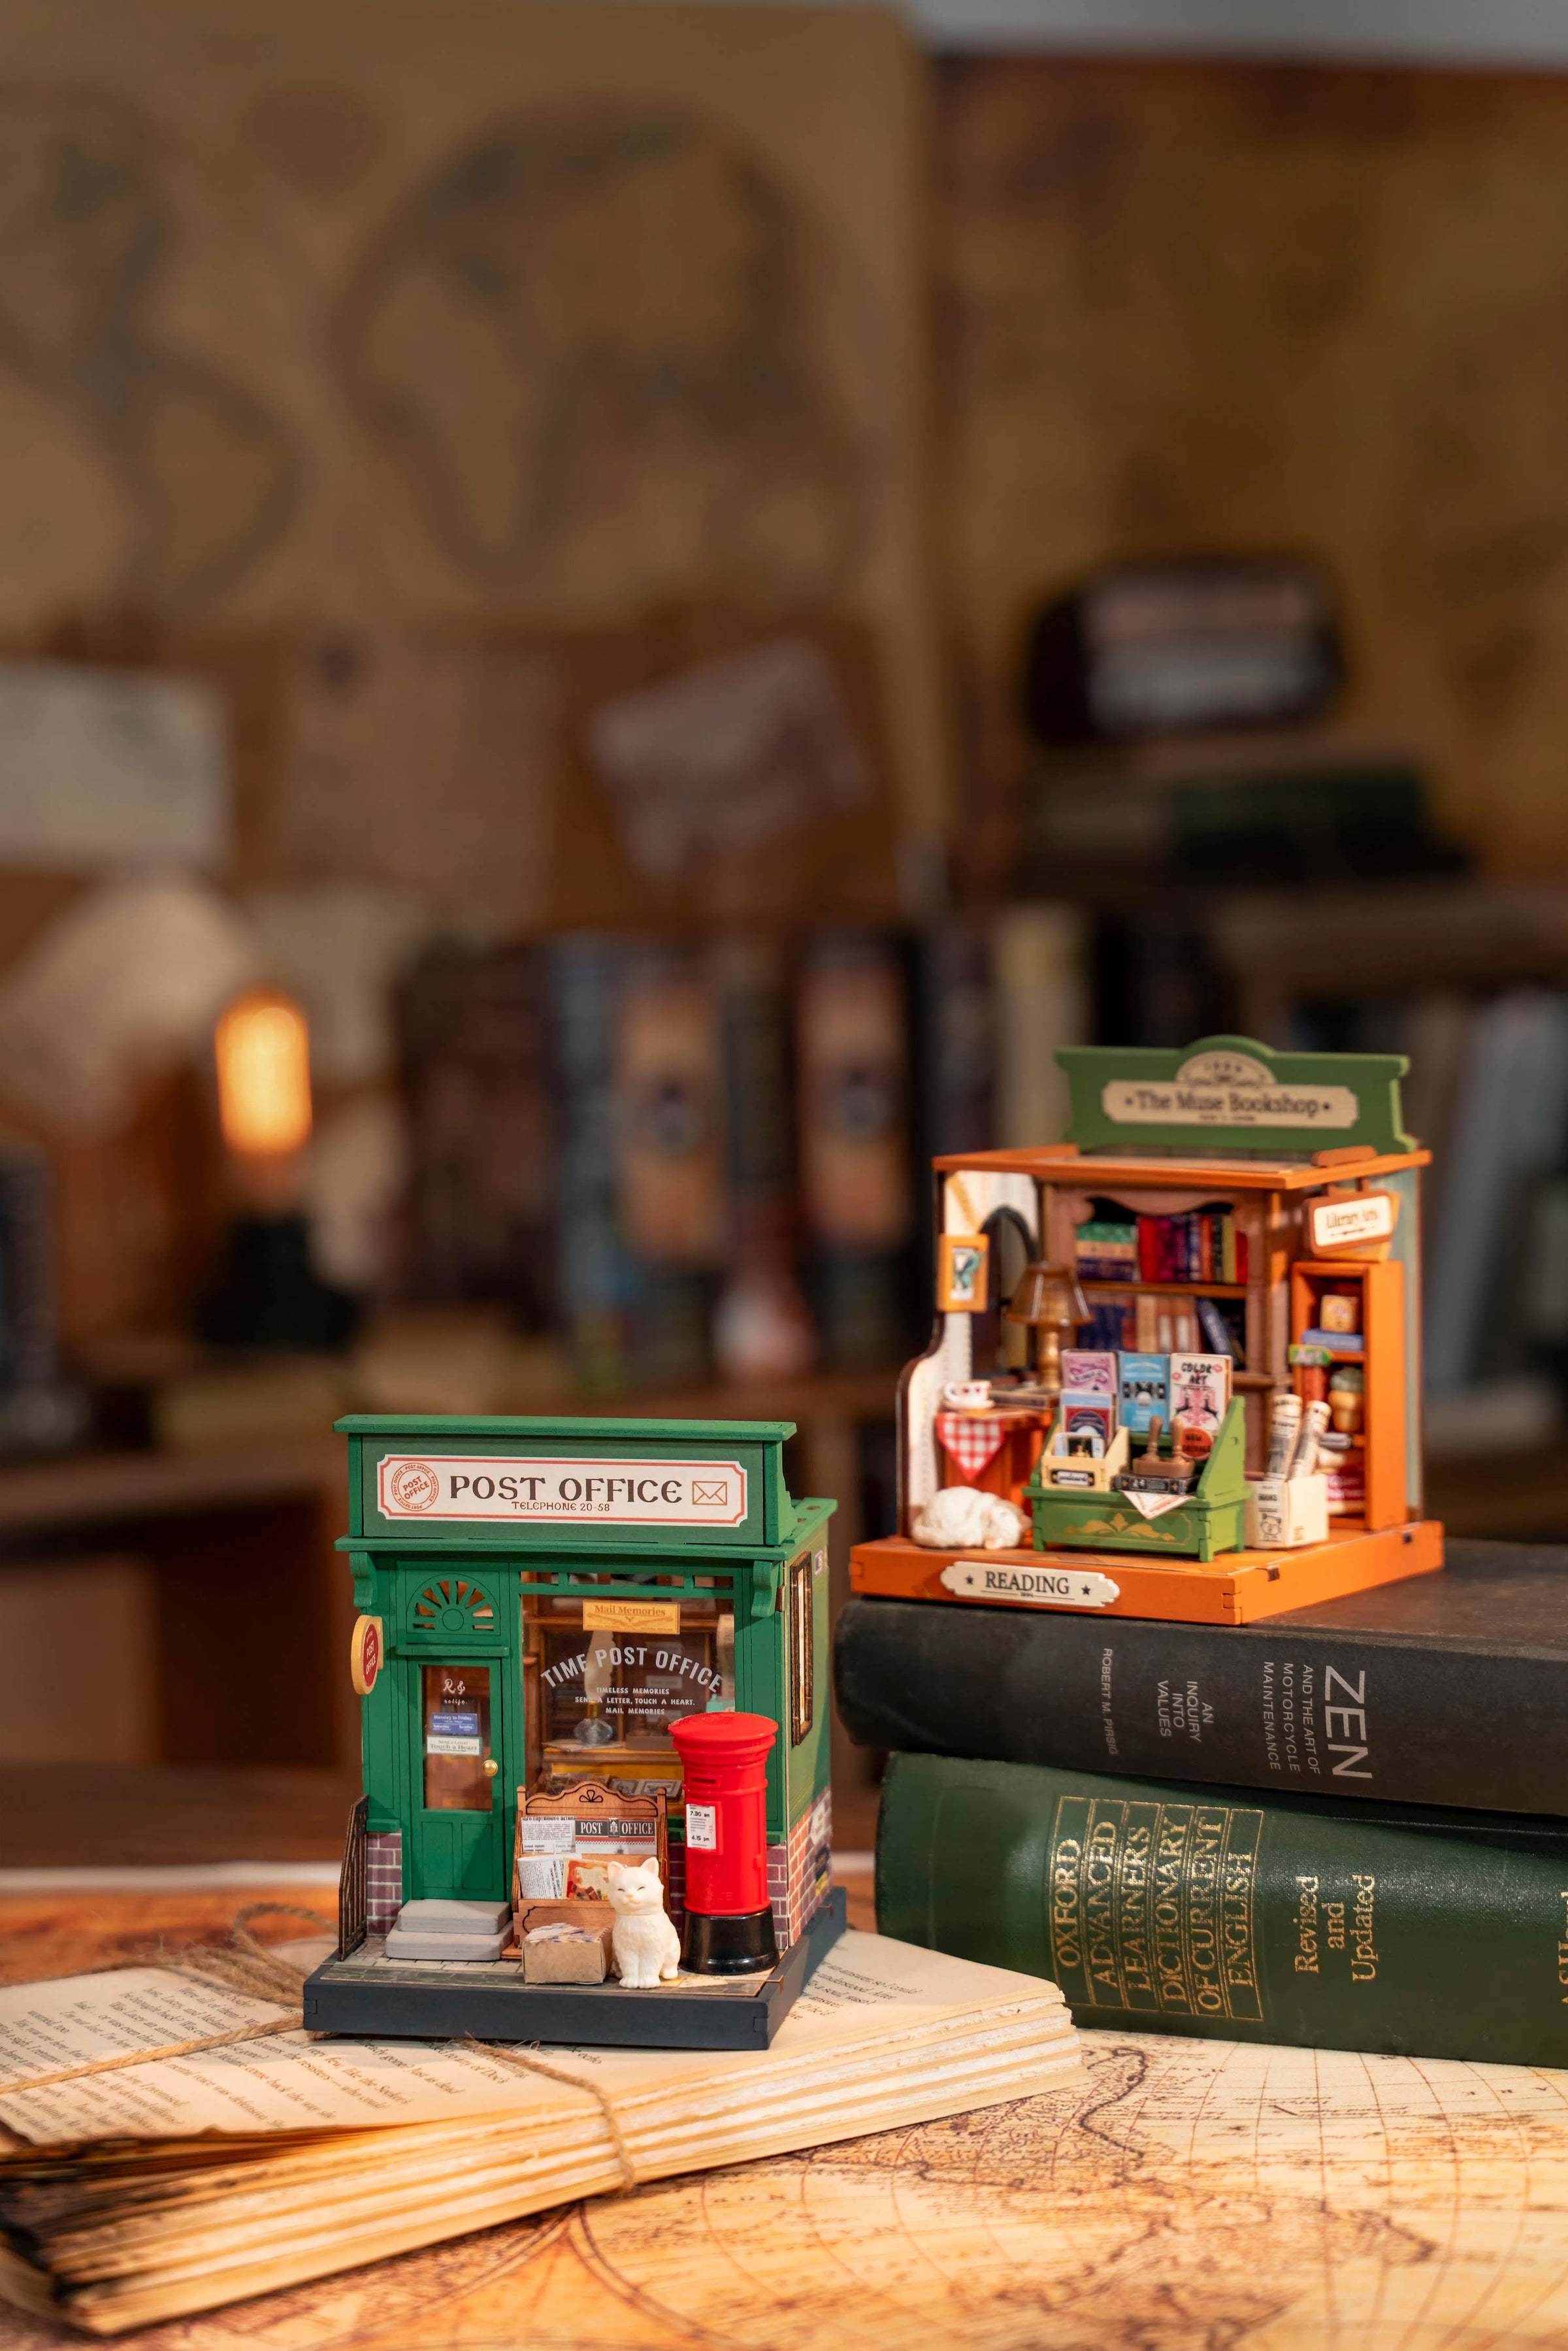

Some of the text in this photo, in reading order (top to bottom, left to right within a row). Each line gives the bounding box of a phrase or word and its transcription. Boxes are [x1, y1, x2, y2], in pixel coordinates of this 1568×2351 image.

[1135, 1089, 1170, 1109] The
[1177, 1092, 1223, 1110] Muse
[1229, 1091, 1319, 1119] Bookshop
[1181, 1362, 1213, 1373] COLOR
[1189, 1375, 1207, 1385] ART
[402, 1475, 422, 1492] POST
[404, 1481, 430, 1500] OFFICE
[449, 1475, 683, 1504] POST OFFICE
[512, 1501, 610, 1511] TELEPHONE 20-58
[985, 1570, 1070, 1594] READING
[595, 1605, 666, 1616] Mail Memories
[540, 1647, 723, 1694] TIME POST OFFICE
[1102, 1648, 1118, 1755] ROBERT M. PIRSIG
[1157, 1680, 1171, 1737] VALUES
[1172, 1693, 1185, 1728] INTO
[1186, 1681, 1202, 1743] INQUIRY
[1201, 1702, 1215, 1724] AN
[1263, 1662, 1281, 1771] MAINTENANCE
[1282, 1663, 1301, 1772] MOTORCYCLE
[1302, 1664, 1320, 1775] AND THE ART OF
[1324, 1665, 1373, 1779] ZEN
[580, 1821, 604, 1835] POST
[621, 1822, 654, 1835] OFFICE
[1054, 1839, 1082, 1969] OXFORD
[1087, 1821, 1120, 1989] ADVANCED
[1155, 1816, 1188, 2002] DICTIONARY
[1190, 1816, 1223, 2011] OF CURRENT
[1224, 1852, 1254, 1988] ENGLISH
[1293, 1875, 1320, 1974] Revised
[1321, 1902, 1345, 1950] and
[1349, 1874, 1379, 1982] Updated
[127, 1996, 164, 2012] brought
[177, 2021, 203, 2030] Was
[120, 2010, 151, 2022] Lacey
[263, 2079, 298, 2092] back
[284, 2092, 312, 2101] the
[358, 2077, 384, 2086] the
